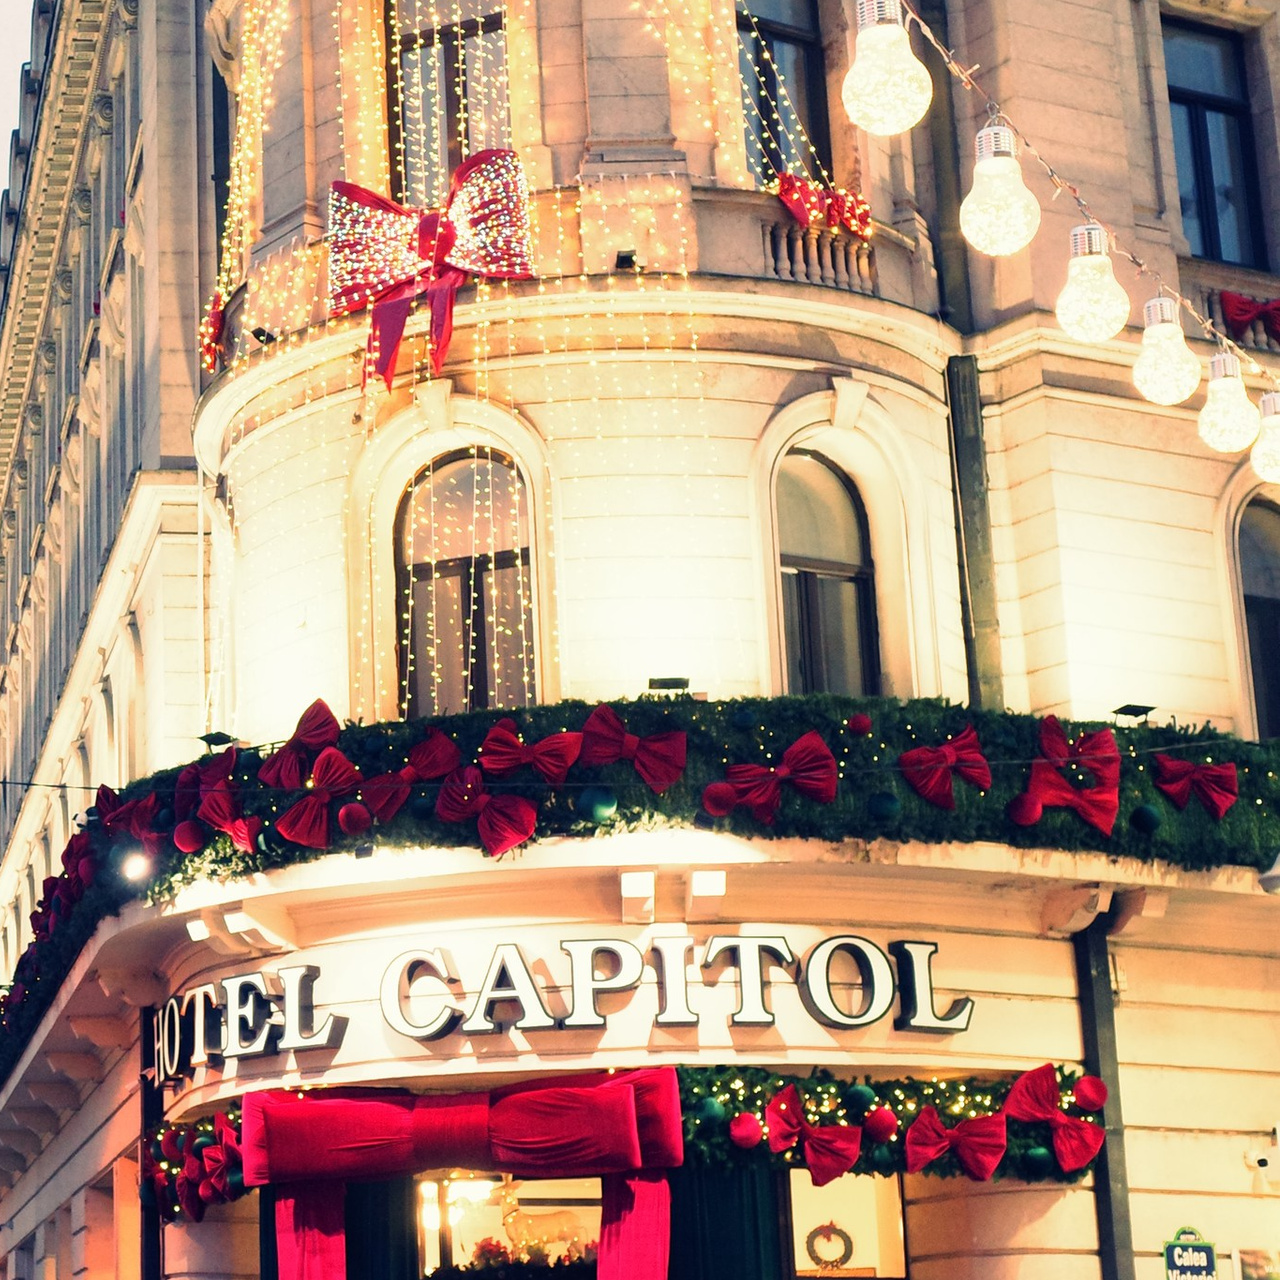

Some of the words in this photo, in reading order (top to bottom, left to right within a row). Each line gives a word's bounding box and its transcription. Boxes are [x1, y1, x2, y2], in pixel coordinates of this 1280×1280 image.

[153, 965, 348, 1089] HOTEL
[379, 935, 975, 1041] CAPITOL
[1173, 1246, 1208, 1267] Calea
